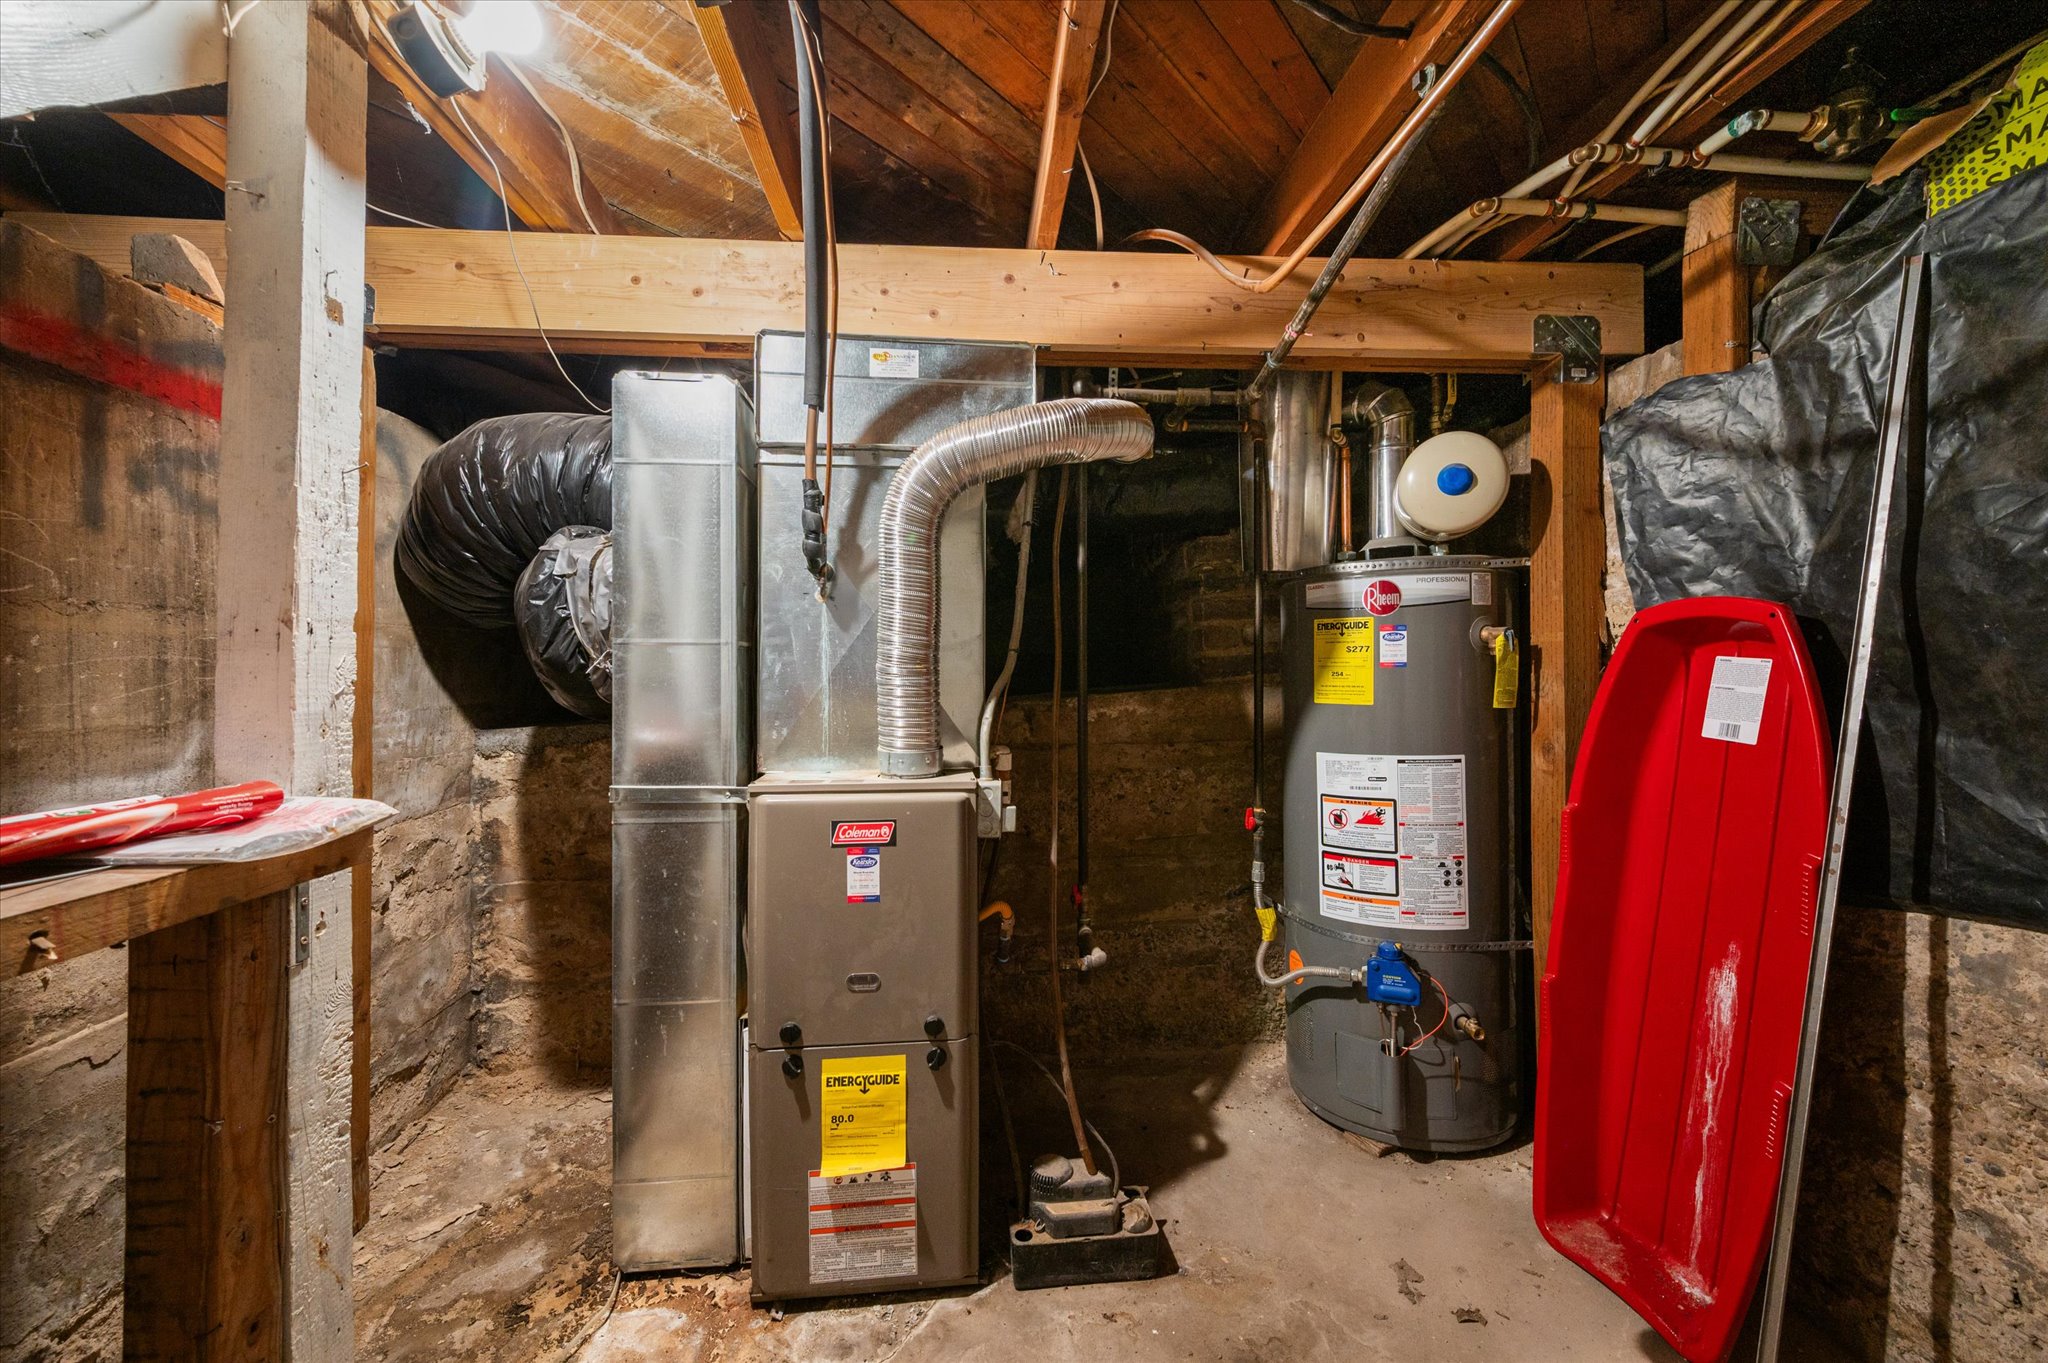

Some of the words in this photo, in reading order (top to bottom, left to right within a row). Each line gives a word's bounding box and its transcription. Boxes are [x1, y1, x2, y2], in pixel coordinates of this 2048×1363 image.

[1416, 575, 1469, 584] PROFESSIONAL
[1367, 581, 1400, 610] Rheem
[1317, 621, 1370, 632] ENERGYGUIDE
[839, 825, 881, 839] Coleman
[826, 1074, 900, 1089] ENERGYGUIDE
[831, 1114, 855, 1124] 80.0
